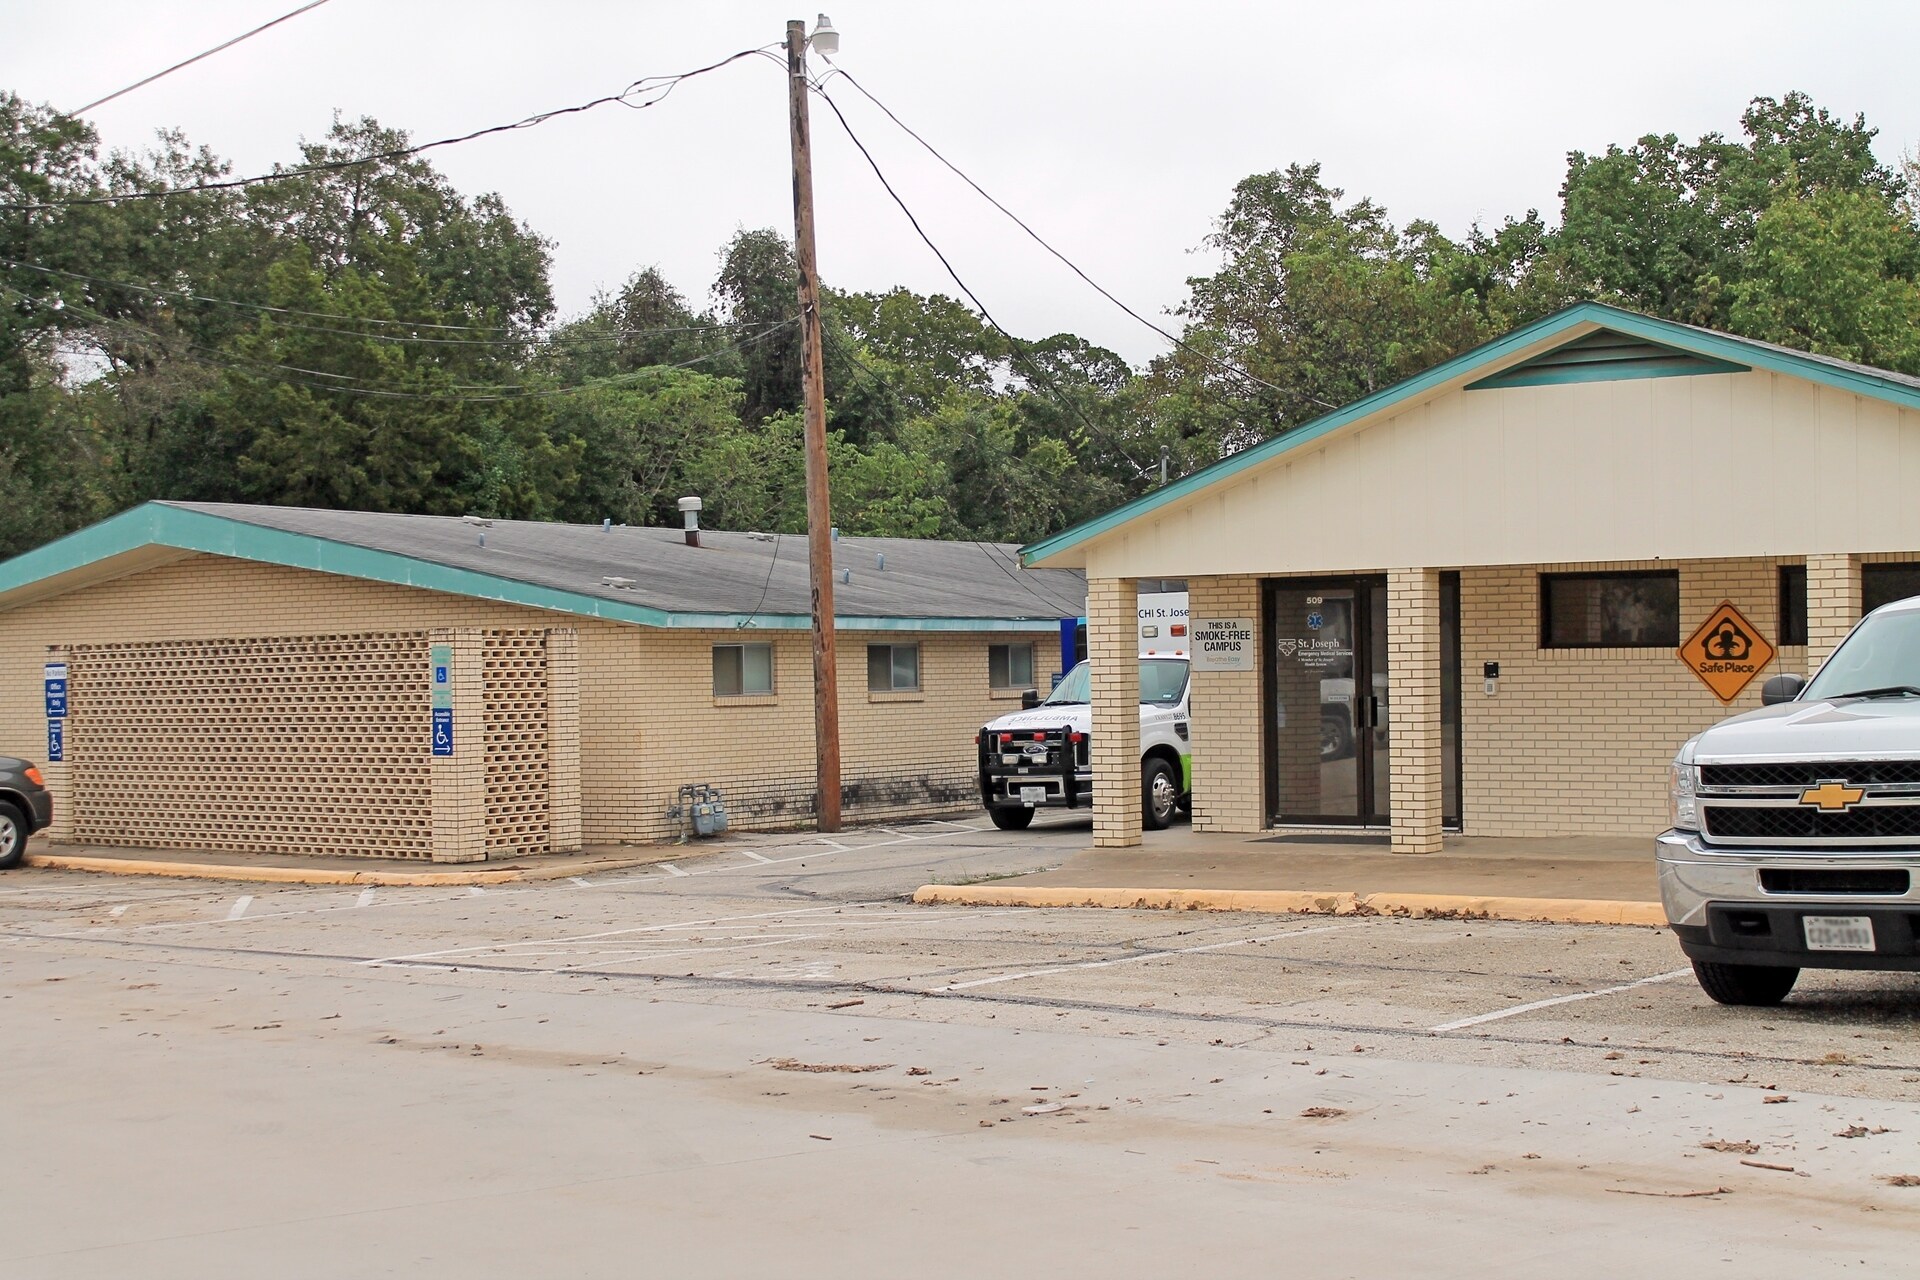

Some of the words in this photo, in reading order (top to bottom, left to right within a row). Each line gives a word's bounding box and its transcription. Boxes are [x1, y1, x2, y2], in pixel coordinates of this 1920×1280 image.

[1306, 596, 1323, 604] 509
[1138, 609, 1154, 618] CHI
[1157, 608, 1168, 618] St.
[1208, 622, 1223, 630] THIS
[1195, 630, 1251, 641] SMOKE-FREE
[1204, 641, 1242, 652] CAMPUS
[1298, 638, 1309, 648] St.
[1310, 638, 1340, 650] Joseph
[1700, 662, 1724, 673] Safe
[1725, 662, 1755, 673] Place
[1173, 712, 1186, 720] 8695
